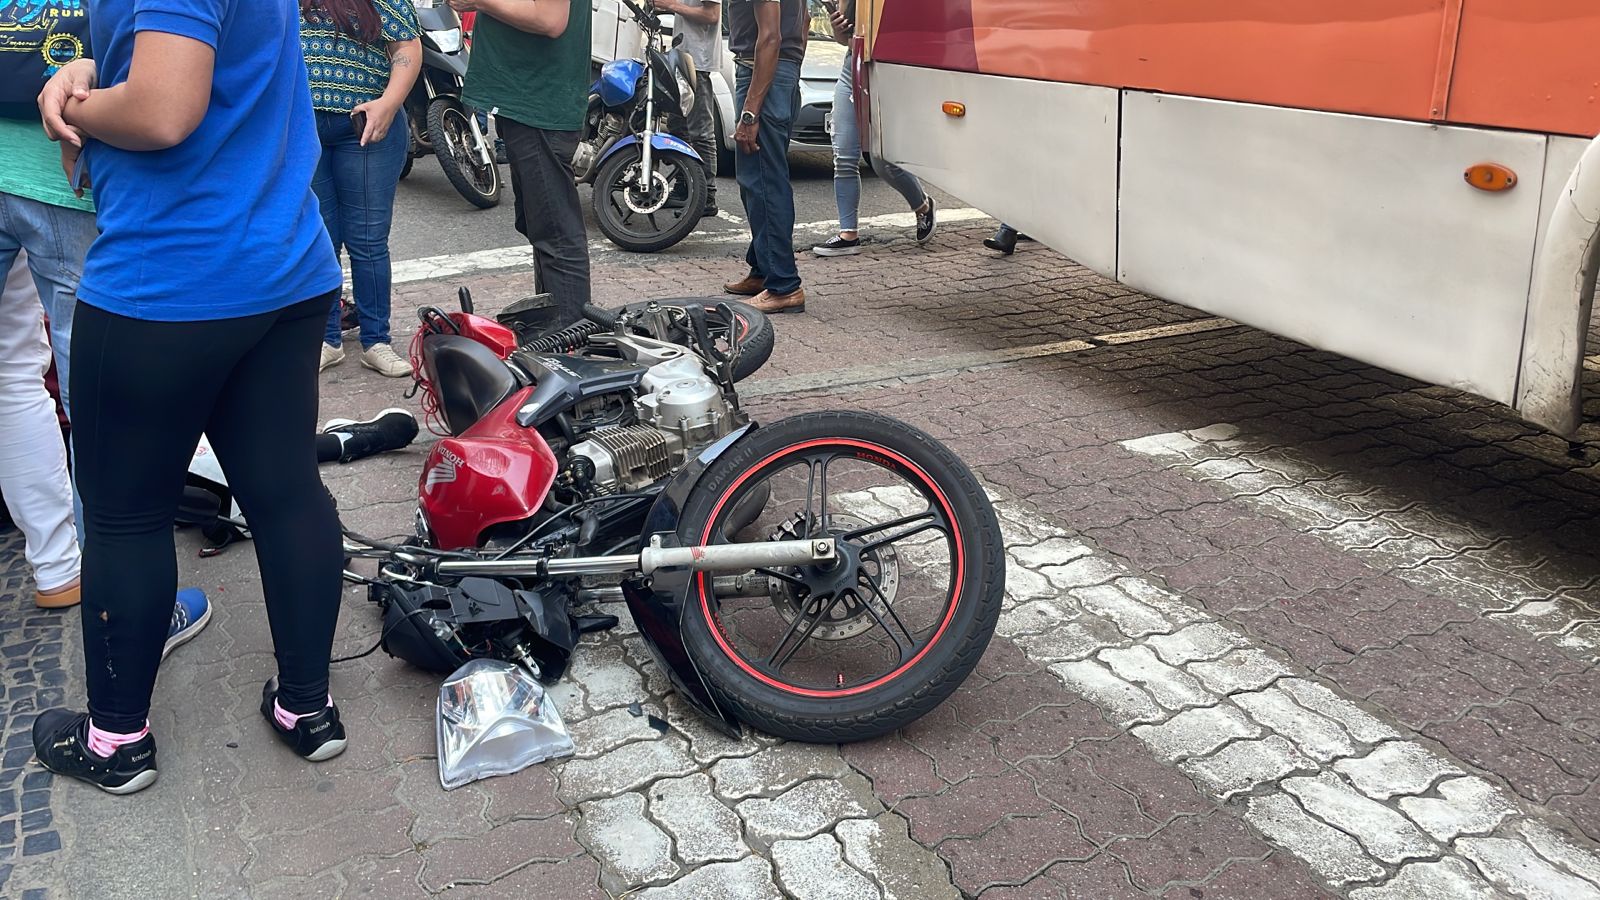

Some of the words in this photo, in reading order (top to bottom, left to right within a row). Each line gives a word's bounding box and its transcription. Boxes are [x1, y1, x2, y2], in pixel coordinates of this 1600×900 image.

[49, 8, 84, 17] RUN
[856, 452, 896, 469] HONDA
[708, 458, 742, 491] DAKAR
